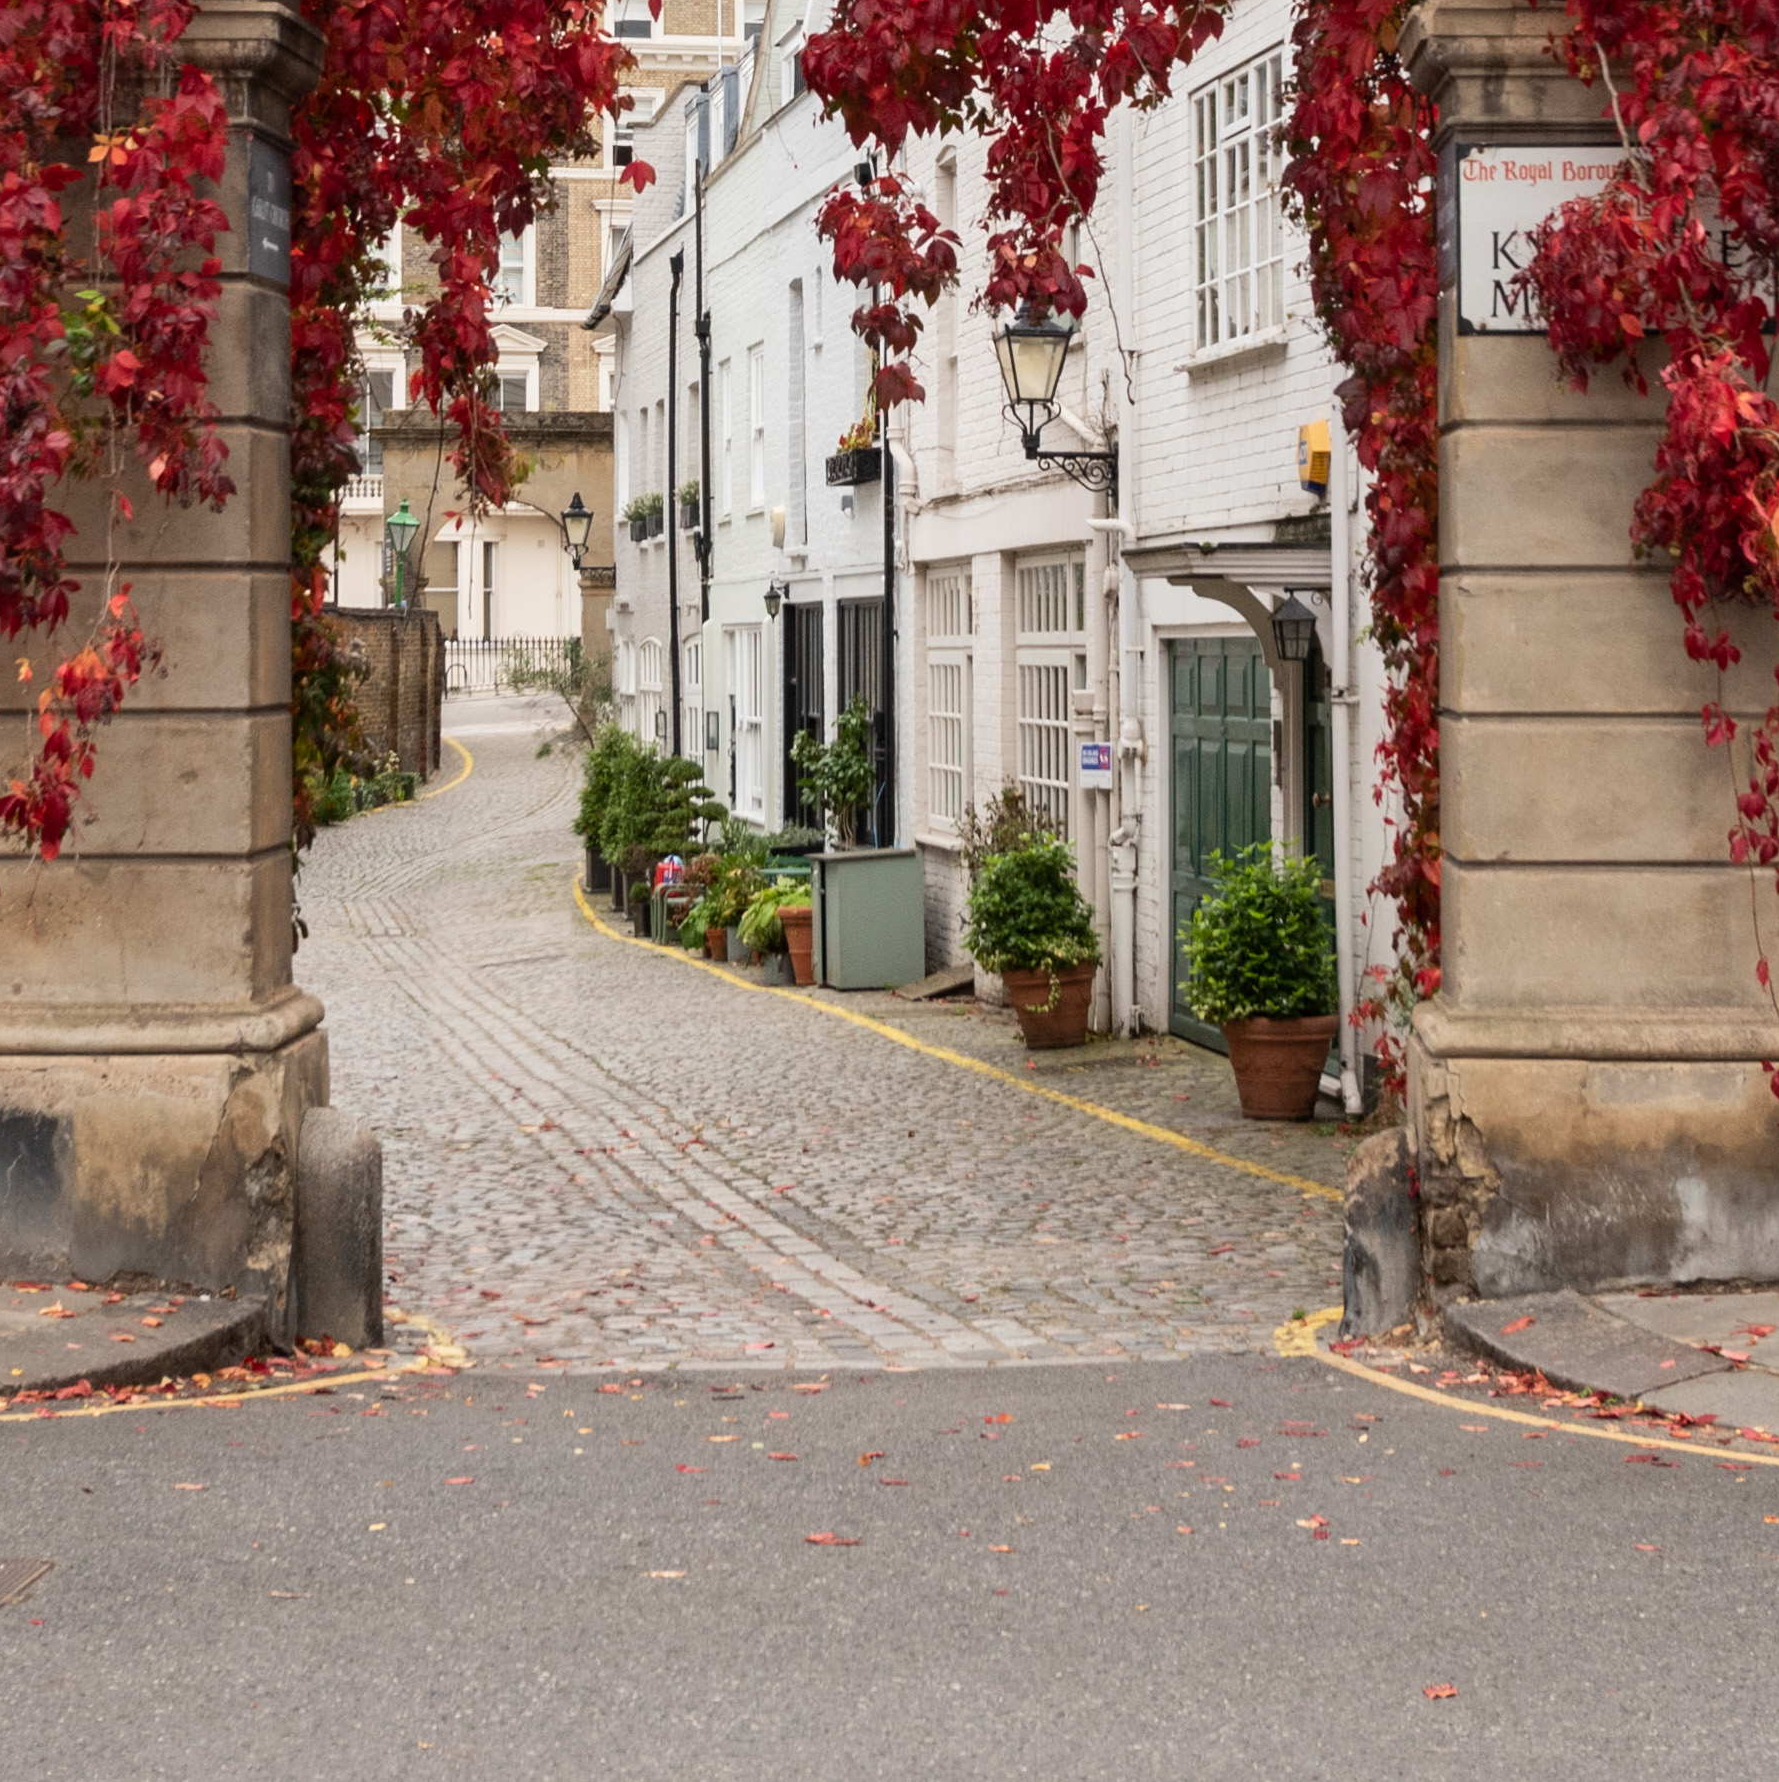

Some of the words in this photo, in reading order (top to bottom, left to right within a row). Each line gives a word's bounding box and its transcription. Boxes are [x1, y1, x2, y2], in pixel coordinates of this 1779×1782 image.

[1463, 159, 1497, 181] The
[1501, 161, 1553, 186] Royal
[1562, 161, 1619, 181] Borou
